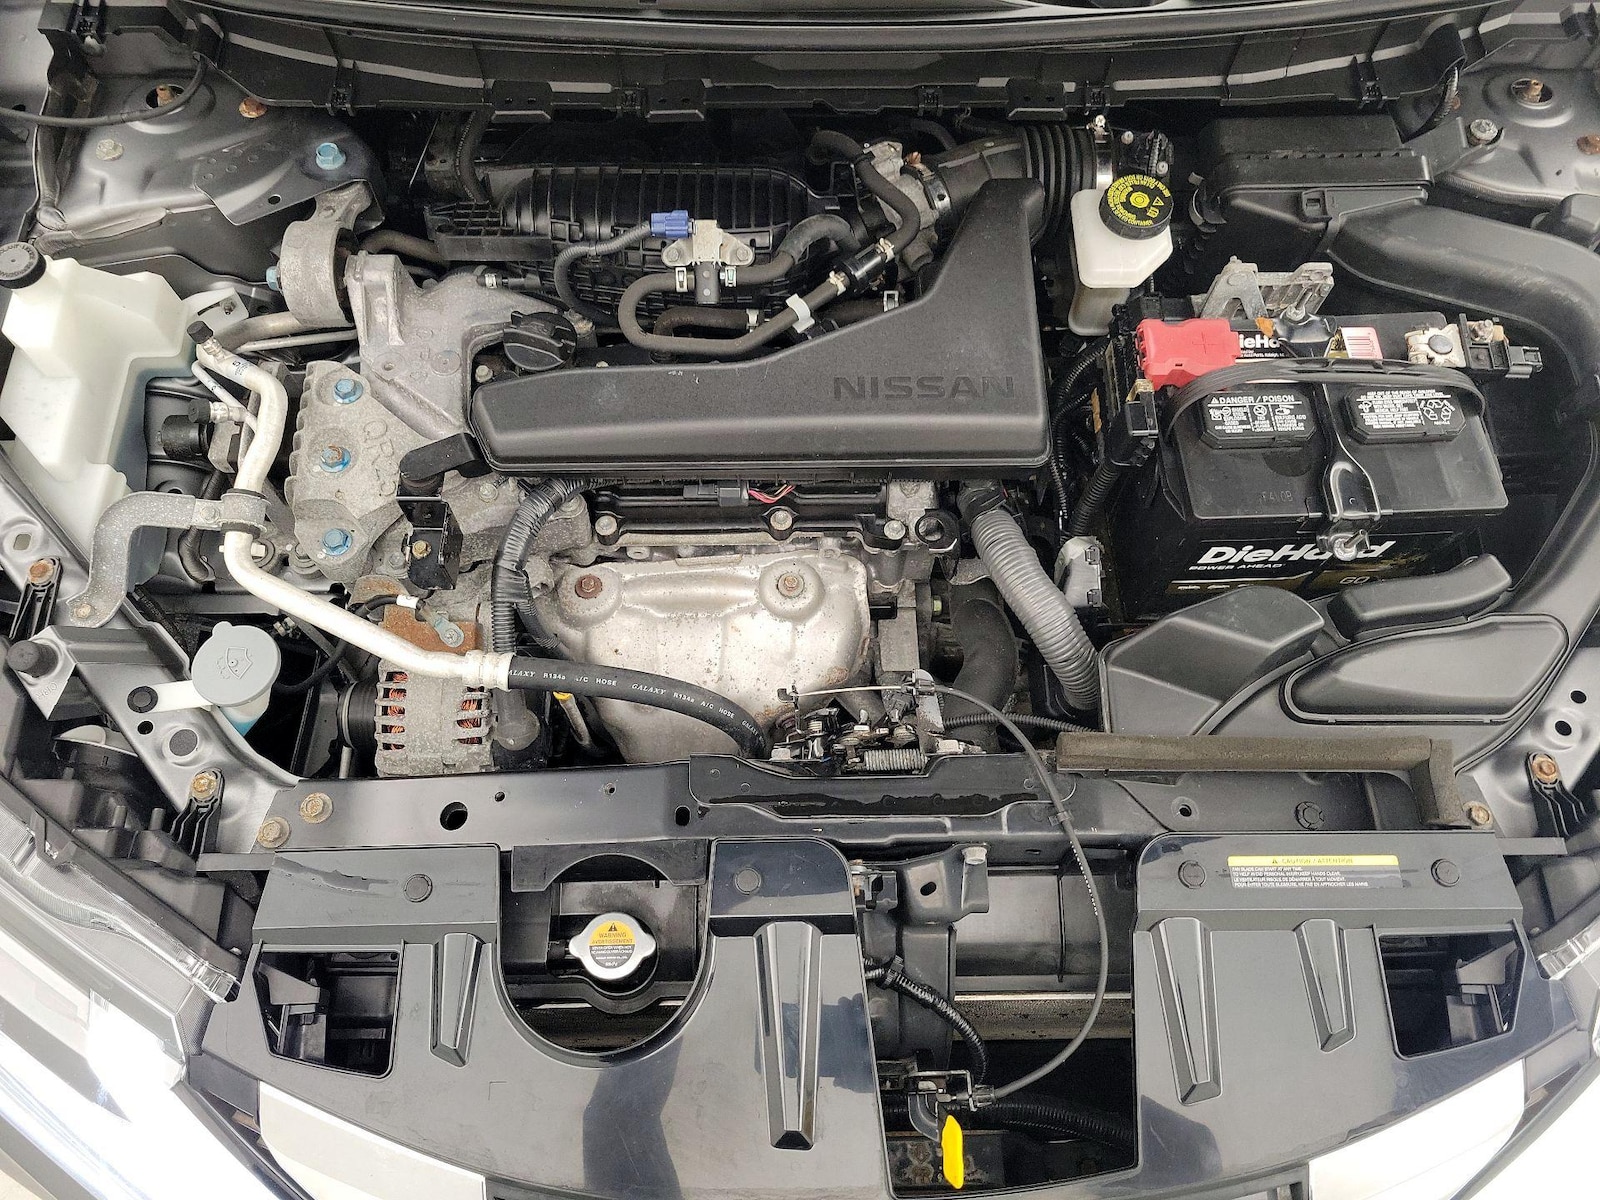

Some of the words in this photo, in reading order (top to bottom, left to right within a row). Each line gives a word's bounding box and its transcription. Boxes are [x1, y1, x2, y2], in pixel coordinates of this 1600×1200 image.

[1239, 334, 1280, 349] ieHa
[834, 376, 1014, 400] NISSAN
[1197, 540, 1396, 564] DieHad
[508, 670, 536, 678] ALAXY
[596, 678, 617, 686] HOSE
[632, 683, 666, 695] GALAXY
[673, 692, 695, 703] R134a
[700, 701, 714, 709] A/C
[719, 708, 735, 719] HOSE
